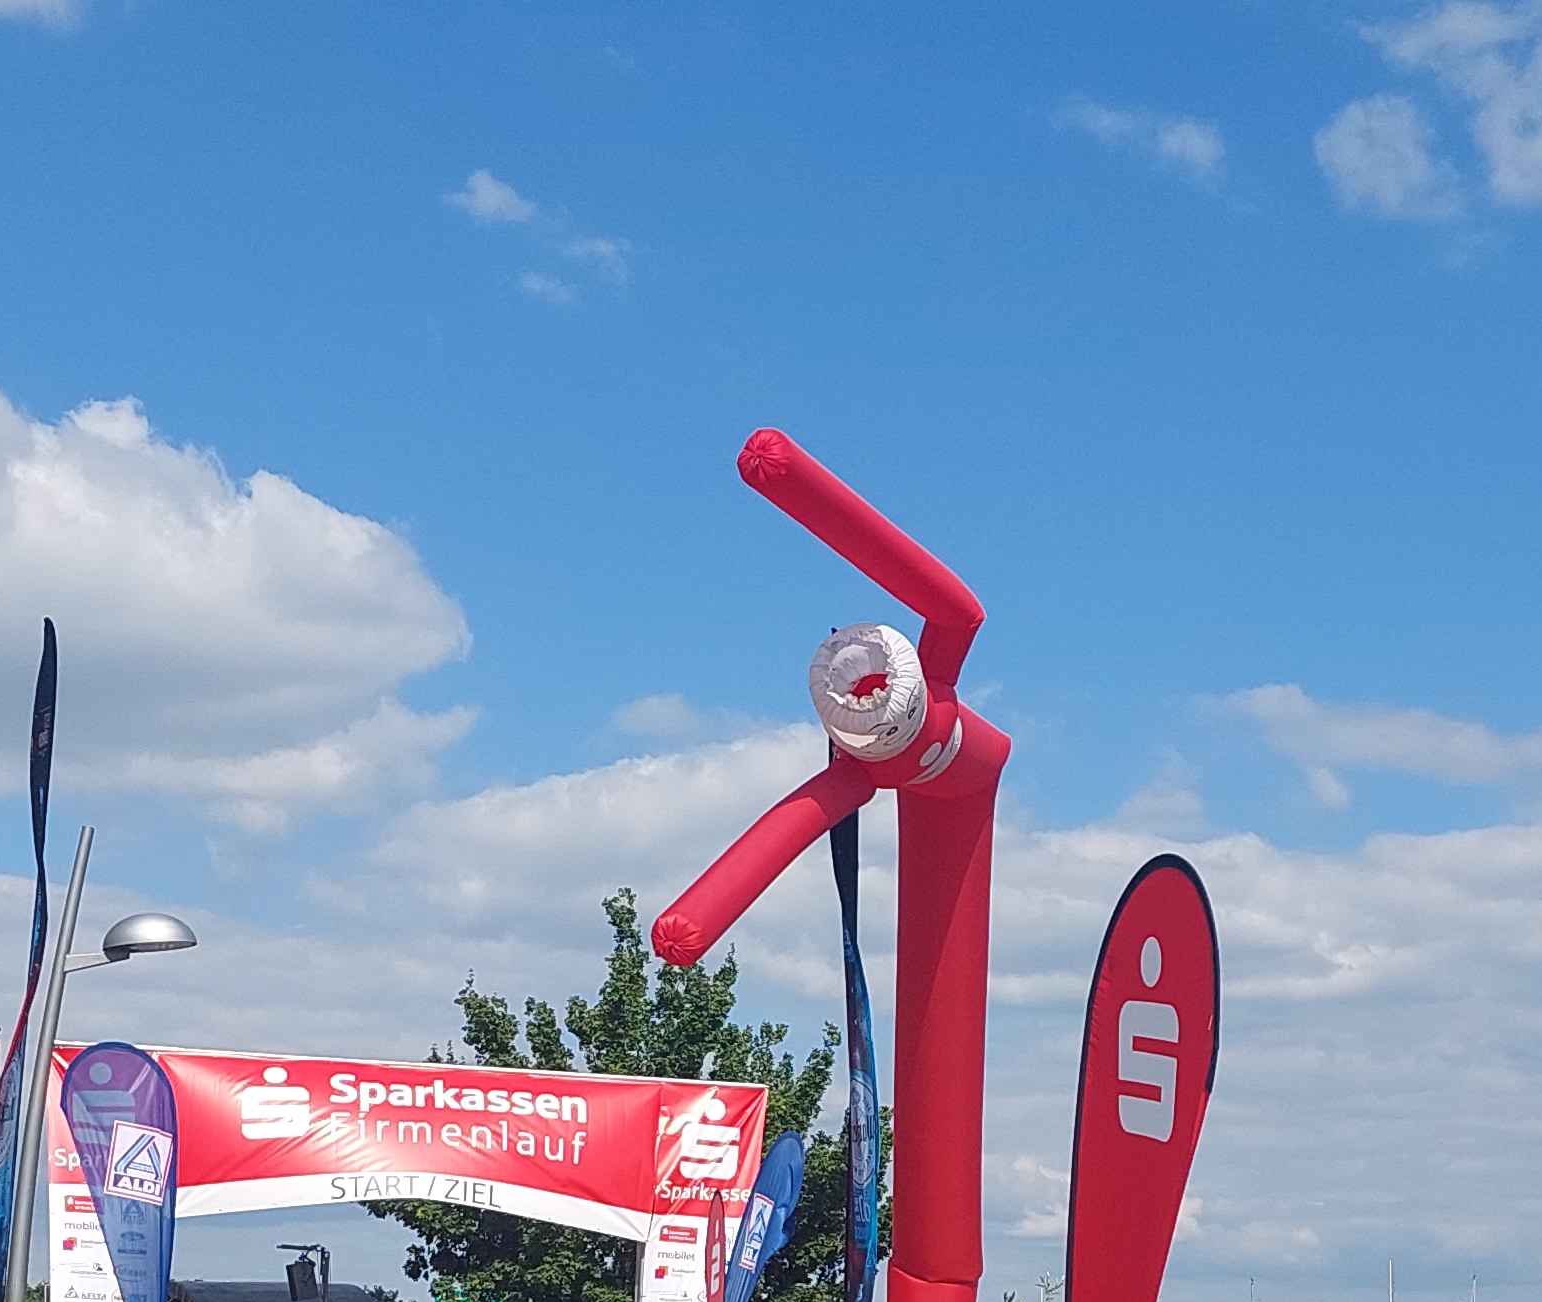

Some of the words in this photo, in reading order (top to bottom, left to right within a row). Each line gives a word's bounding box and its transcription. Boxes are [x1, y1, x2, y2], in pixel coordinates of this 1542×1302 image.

[329, 1073, 588, 1123] Sparkassen
[329, 1111, 588, 1165] Firmenlauf
[118, 1175, 162, 1197] ALDI
[331, 1175, 420, 1200] START
[445, 1178, 502, 1209] ZIEL
